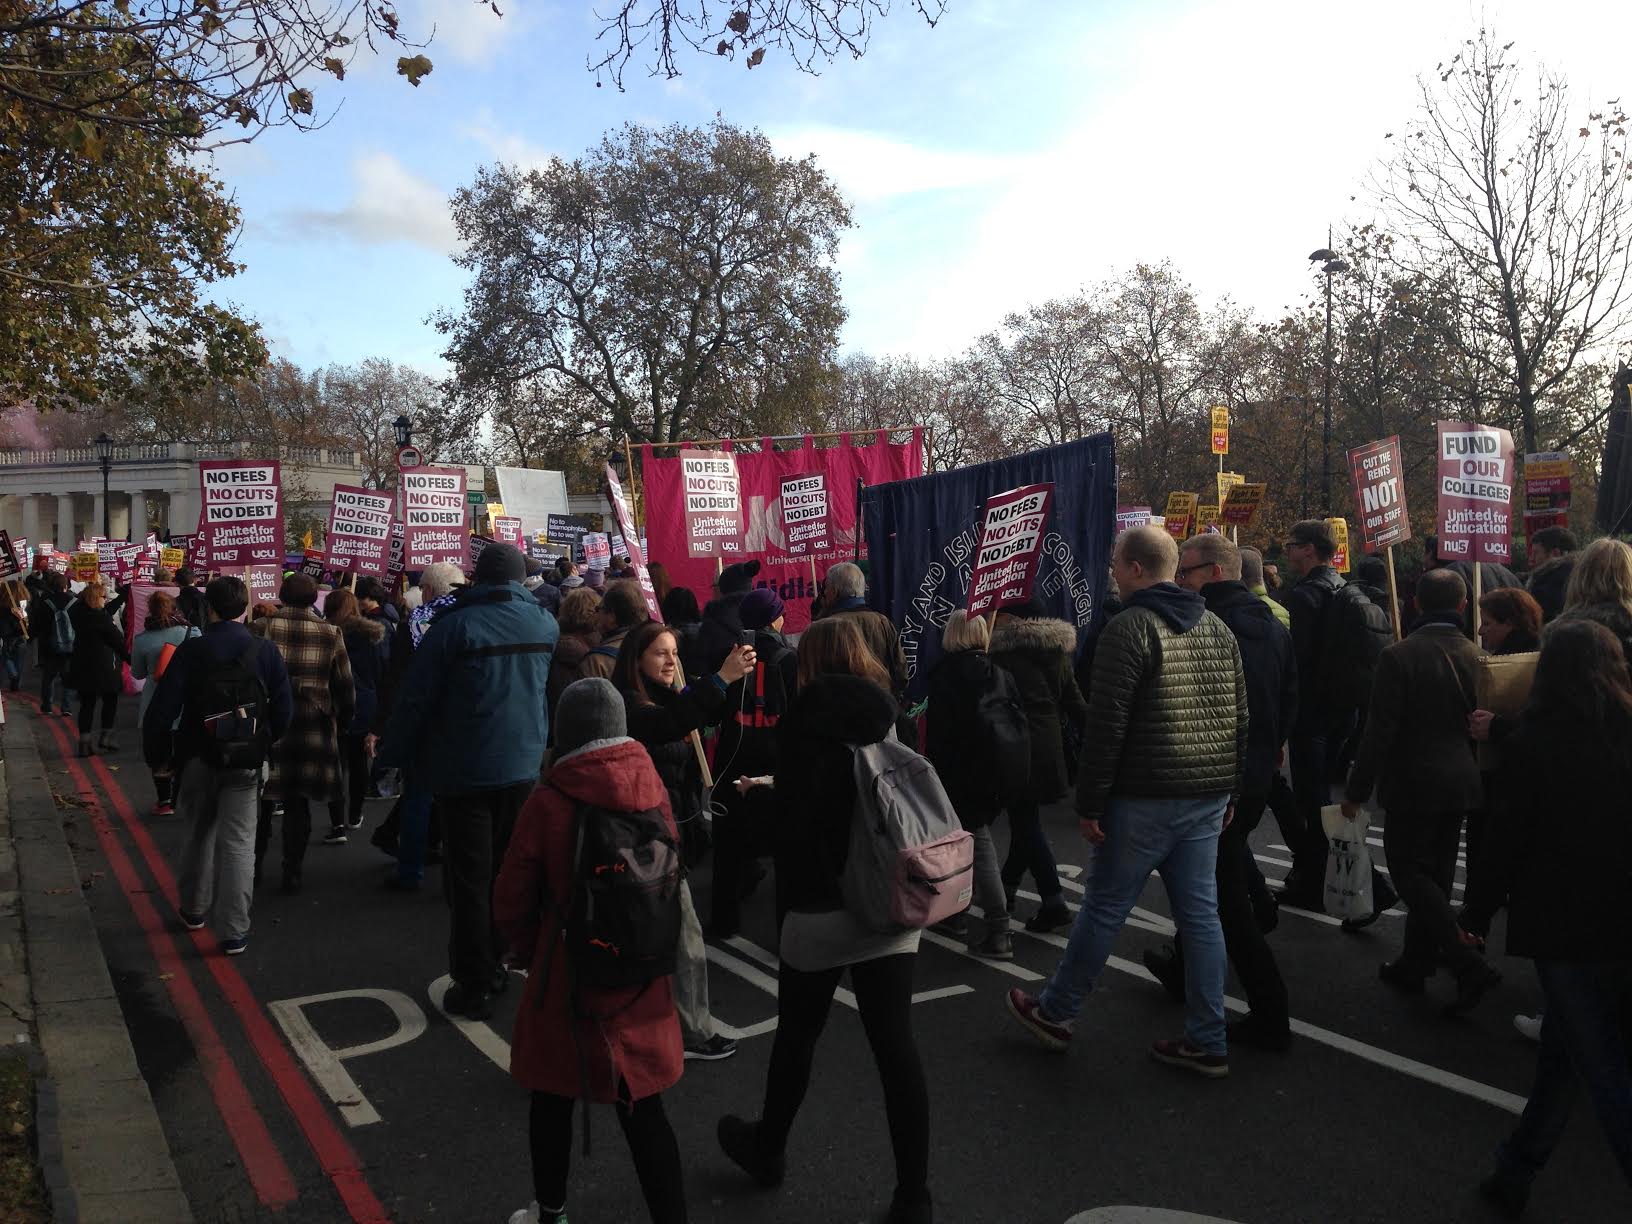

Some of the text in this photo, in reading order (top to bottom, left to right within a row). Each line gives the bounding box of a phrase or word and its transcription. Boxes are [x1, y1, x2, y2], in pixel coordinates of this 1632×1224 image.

[1446, 437, 1497, 455] FUND
[686, 461, 729, 473] NO FEES
[1363, 451, 1391, 470] CUT THE
[1367, 464, 1391, 480] RENTS
[1463, 460, 1500, 477] OUR
[206, 470, 267, 483] NO FEES
[407, 476, 455, 489] NO FEES
[688, 477, 735, 492] NO CUTS
[783, 479, 819, 493] NO FEES
[1444, 480, 1510, 500] COLLEGES
[210, 488, 274, 500] NO CUTS
[409, 493, 461, 508] NO CUTS
[785, 493, 825, 506] NO CUTS
[1363, 478, 1398, 513] NOT
[337, 493, 386, 509] NO FEES
[689, 497, 735, 508] NO DEBT
[210, 505, 273, 518] NO DEBT
[337, 507, 388, 524] NO CUTS
[786, 505, 825, 520] NO DEBT
[988, 496, 1039, 525] NO FEES
[1117, 511, 1150, 520] EDUCATION
[1447, 508, 1508, 524] United for
[410, 512, 460, 523] NO DEBT
[694, 515, 737, 528] United for
[1126, 520, 1143, 528] NOT
[1367, 507, 1402, 528] OUR STAFF
[215, 523, 275, 538] United for
[335, 522, 386, 537] NO DEBT
[692, 525, 737, 537] Education
[790, 521, 816, 535] United
[985, 518, 1040, 543] NO CUTS
[1444, 520, 1508, 534] Education
[212, 534, 275, 547] Education
[413, 530, 461, 542] United for
[789, 528, 827, 542] Education
[335, 538, 383, 551] United for
[411, 539, 461, 551] Education
[588, 542, 606, 552] END
[693, 541, 712, 551] nus
[790, 543, 806, 553] nus
[980, 536, 1035, 565] NO DEBT
[1444, 540, 1469, 553] nus
[117, 547, 142, 556] BOYCOTT
[213, 550, 238, 560] nus
[332, 545, 381, 558] Education
[766, 554, 815, 566] University
[817, 550, 836, 560] and
[329, 557, 351, 567] nus
[411, 555, 433, 565] nus
[138, 567, 156, 576] ALL
[262, 572, 275, 580] for
[303, 566, 323, 577] OUT
[978, 560, 1029, 584] United for
[912, 562, 946, 620] AND
[1042, 532, 1092, 628] COLLEGE
[974, 571, 1025, 596] Education
[971, 594, 993, 612] nus
